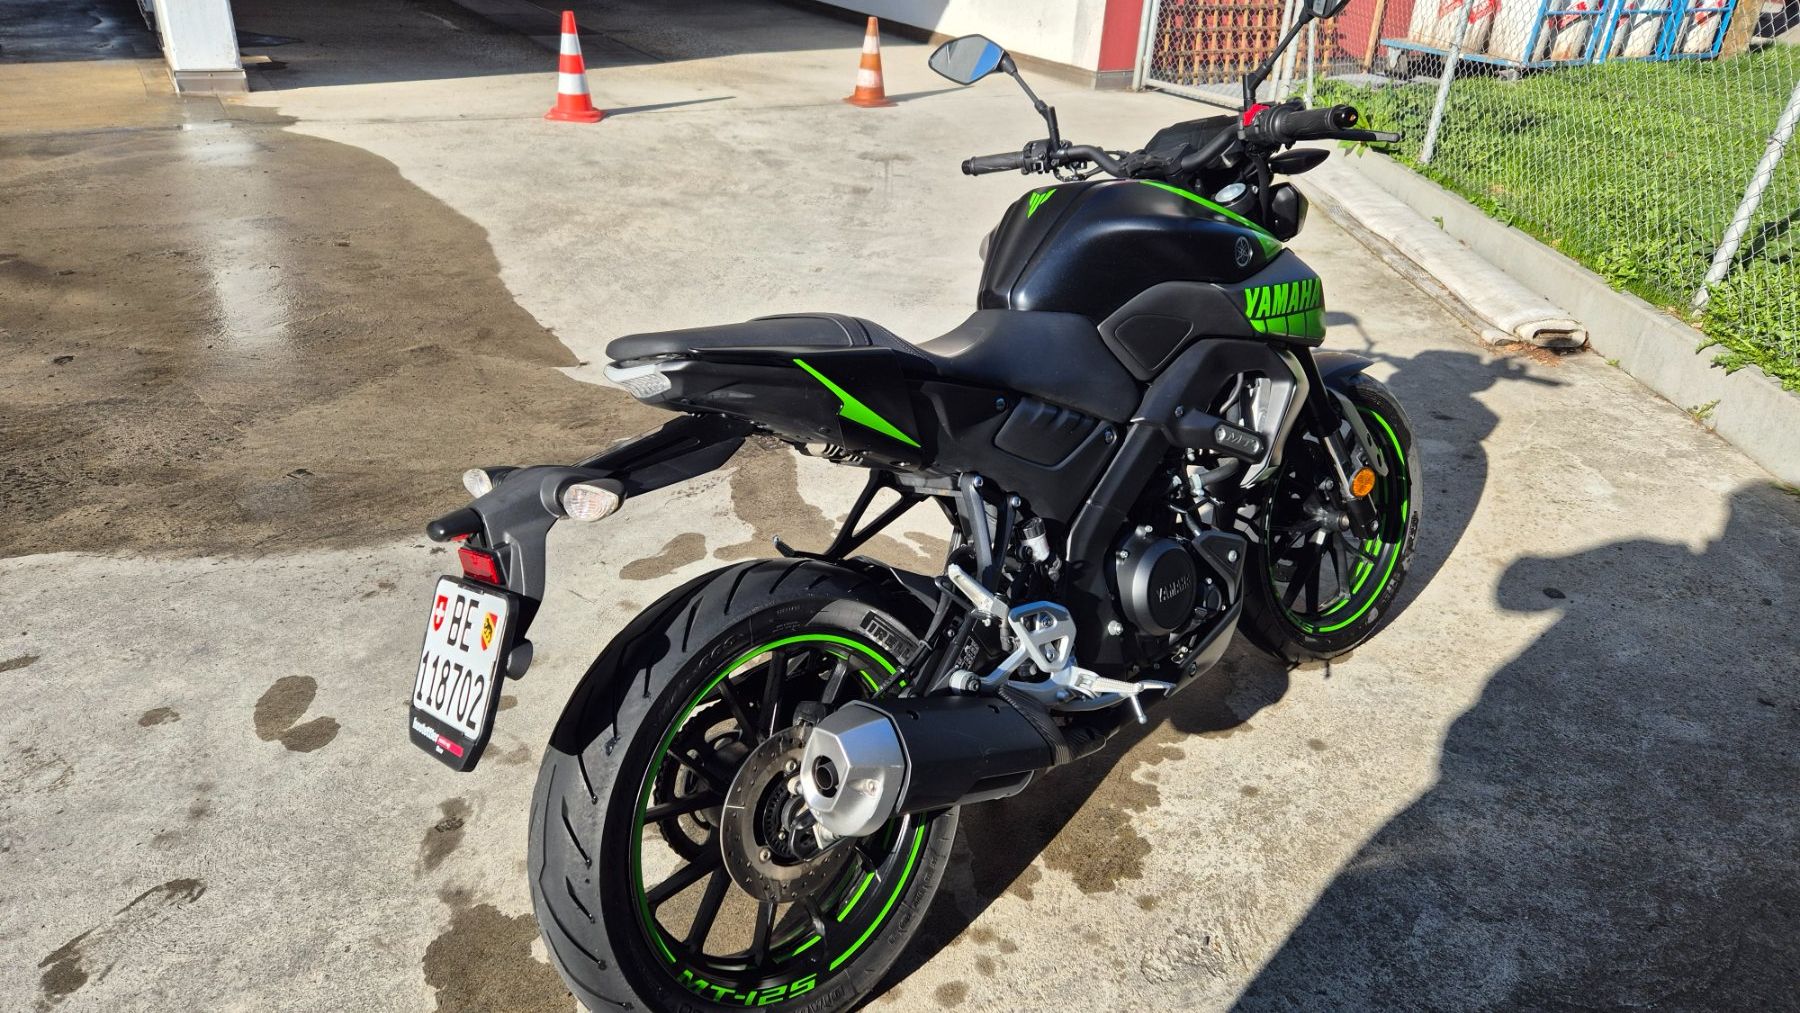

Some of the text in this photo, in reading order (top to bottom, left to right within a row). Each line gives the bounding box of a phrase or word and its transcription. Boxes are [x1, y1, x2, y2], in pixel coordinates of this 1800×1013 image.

[1244, 277, 1321, 319] YAMAHA
[447, 594, 480, 653] BE
[416, 650, 485, 730] 118702
[677, 969, 817, 1007] MT-125
